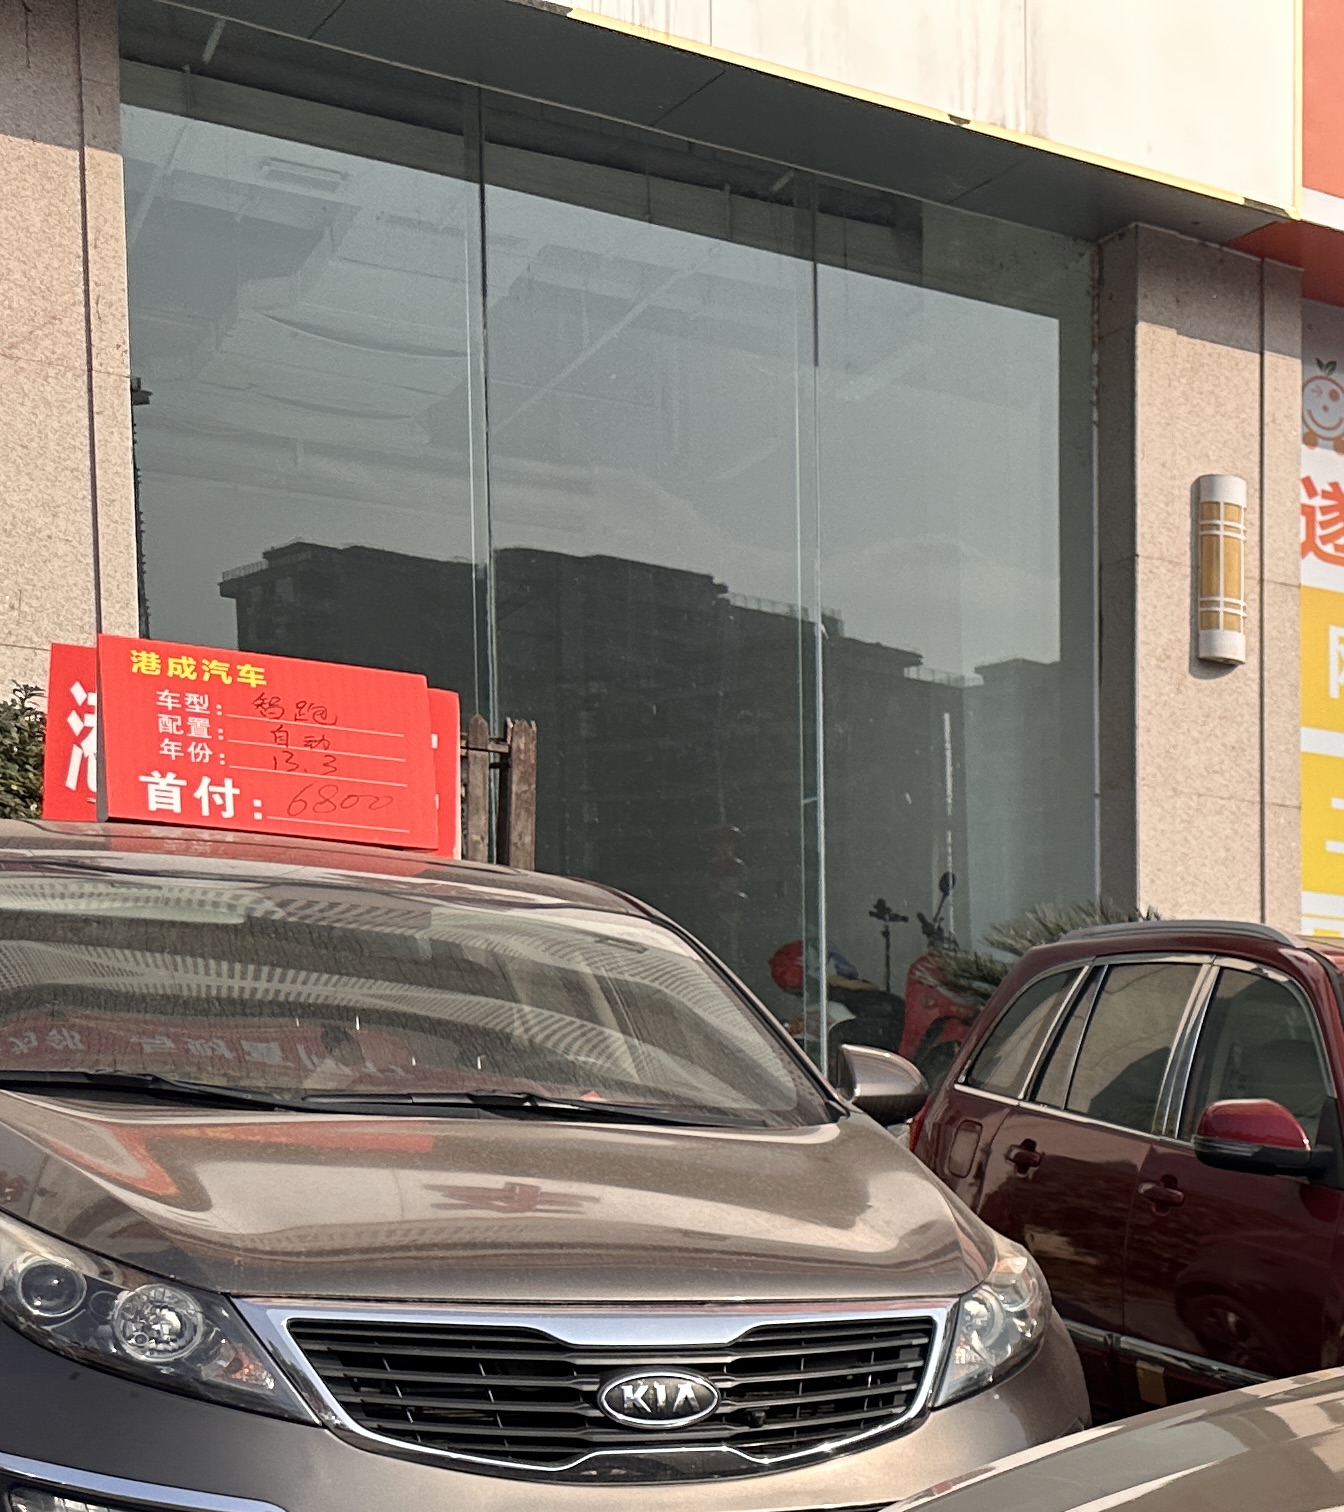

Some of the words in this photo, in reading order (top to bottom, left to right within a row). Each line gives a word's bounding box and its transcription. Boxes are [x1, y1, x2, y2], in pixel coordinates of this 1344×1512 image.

[130, 649, 268, 688] 港成汽车
[286, 782, 394, 817] 6800
[622, 1382, 699, 1414] KIA
